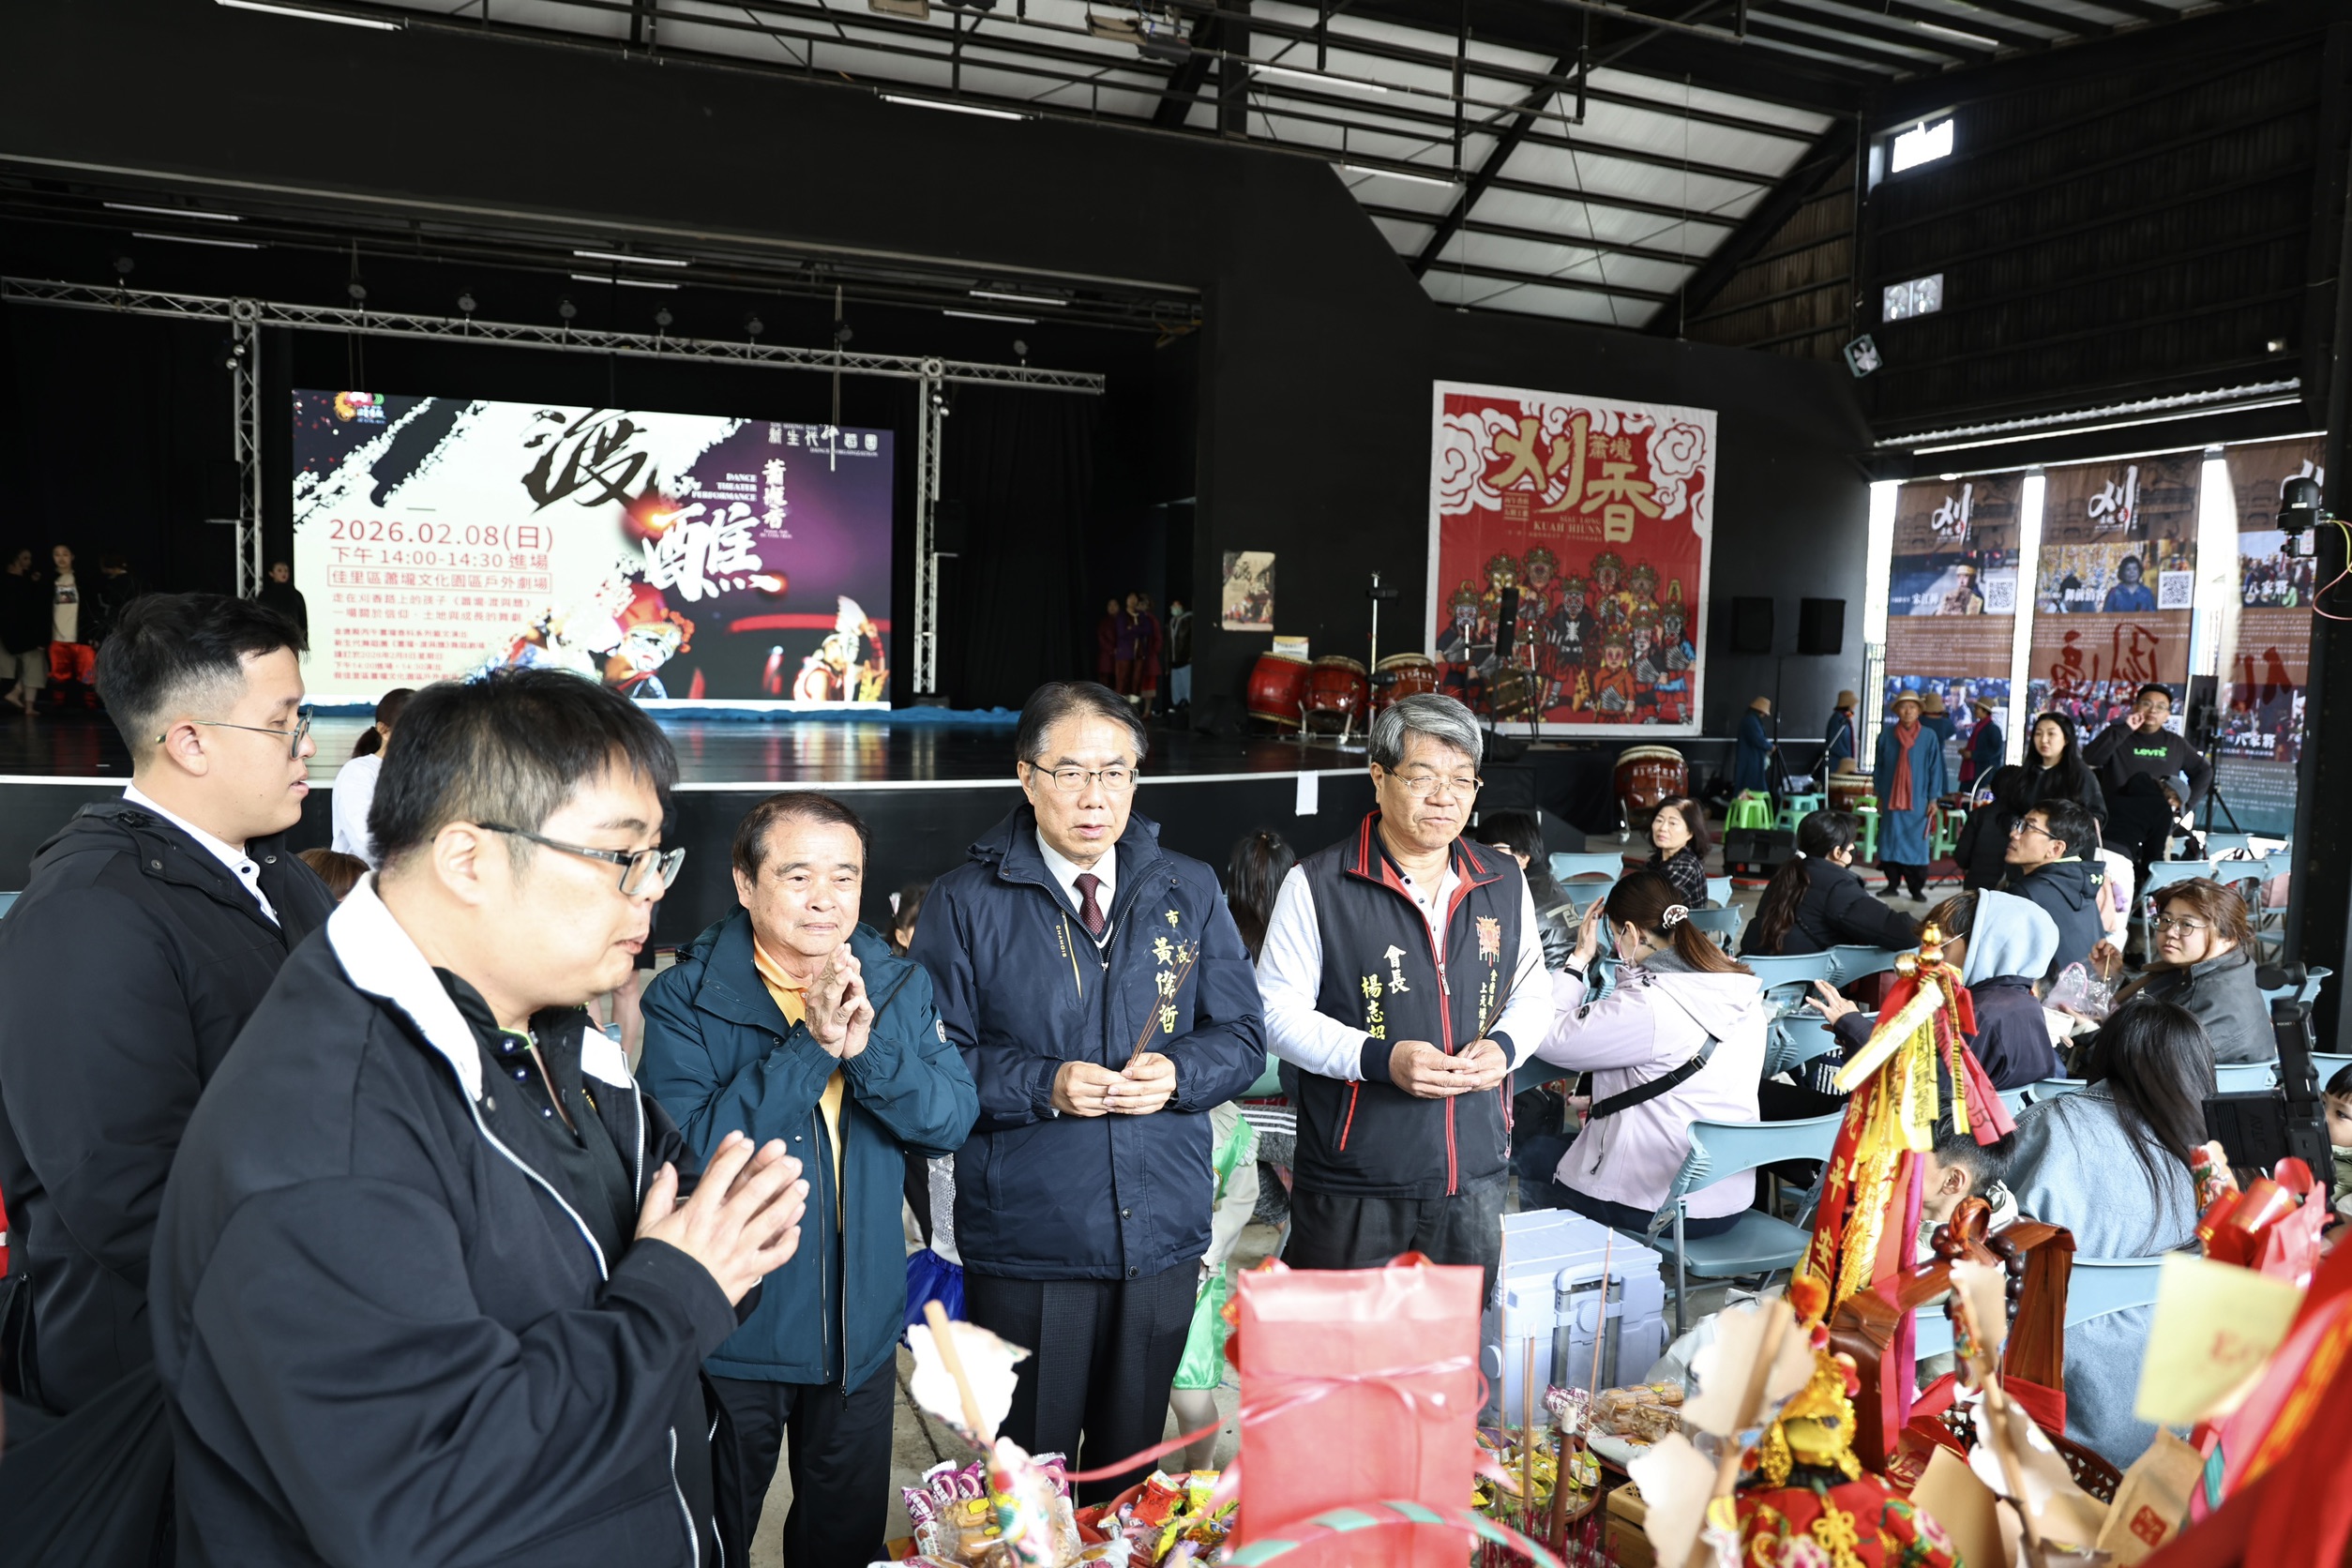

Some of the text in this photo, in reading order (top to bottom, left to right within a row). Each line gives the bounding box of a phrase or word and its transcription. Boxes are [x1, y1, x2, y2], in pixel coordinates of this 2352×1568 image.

[716, 482, 758, 492] THEATER
[726, 473, 758, 483] DANCE
[691, 490, 758, 502] PERFORMANCE
[329, 518, 553, 553] 2026.02.08(日)
[1533, 520, 1564, 533] KUAH
[331, 546, 550, 570] 下午 14:00-14:30 進場
[1055, 925, 1068, 958] CHAMOIS
[1383, 944, 1411, 995] 會長
[1152, 936, 1180, 1034] 黃偉哲
[1816, 1074, 1868, 1273] 境平安
